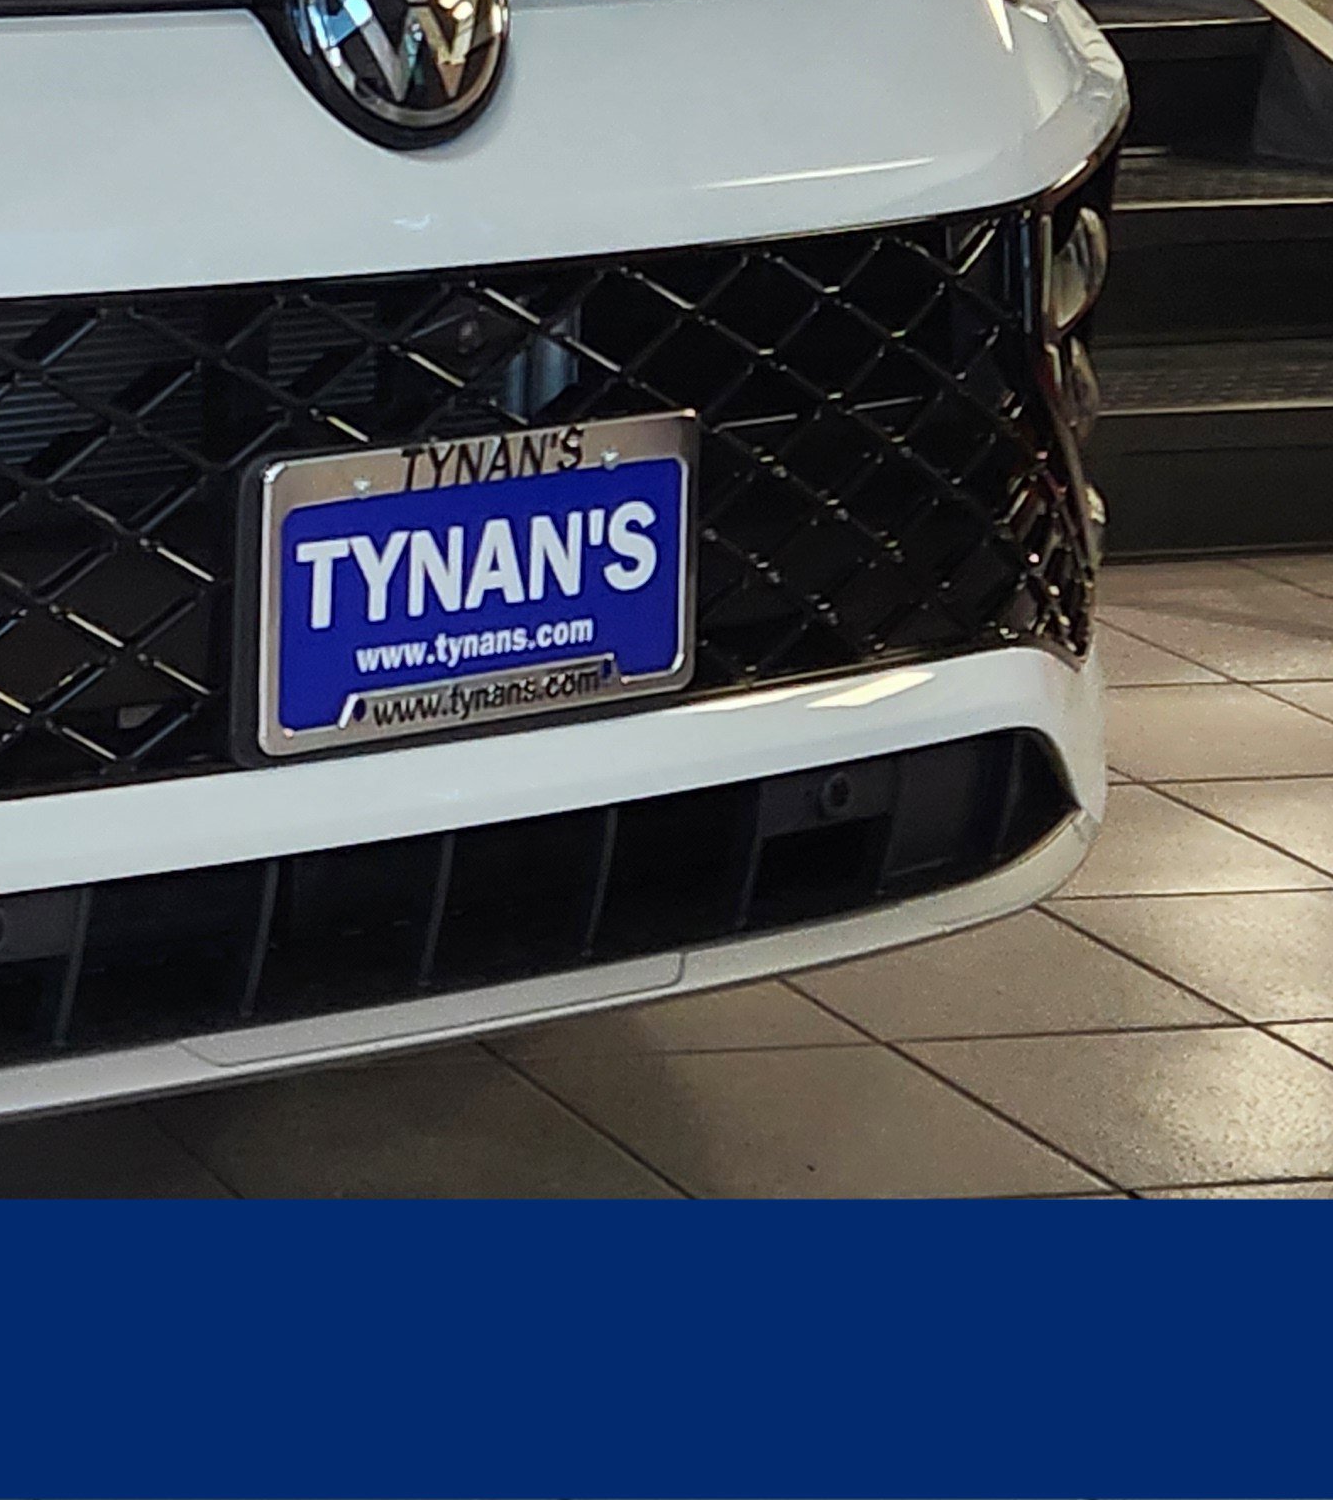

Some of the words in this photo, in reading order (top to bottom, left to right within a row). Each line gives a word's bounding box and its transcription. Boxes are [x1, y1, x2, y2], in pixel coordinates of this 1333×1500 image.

[401, 425, 585, 491] TYNAN'S
[295, 500, 658, 630] TYNAN'S
[355, 618, 594, 673] www.tynans.com
[372, 669, 599, 727] www.tynans.com
